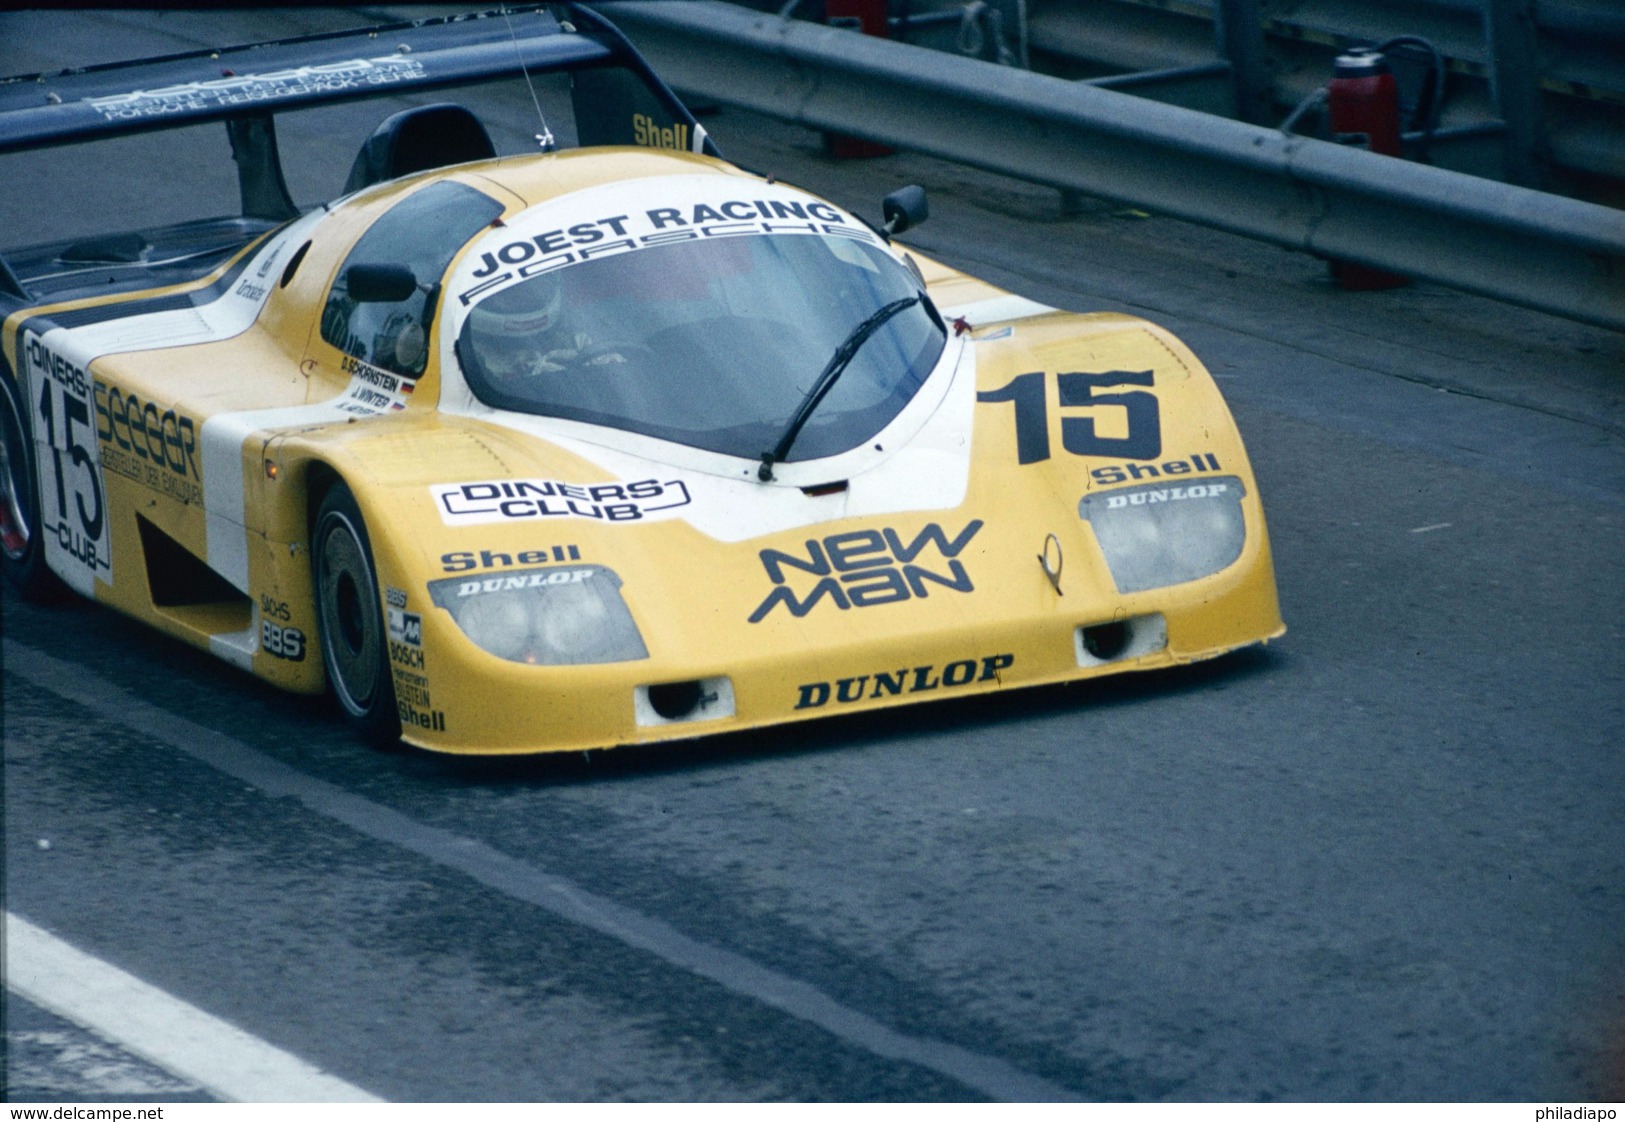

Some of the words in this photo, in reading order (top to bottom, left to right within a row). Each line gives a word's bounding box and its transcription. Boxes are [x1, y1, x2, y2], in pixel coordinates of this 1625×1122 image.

[633, 113, 687, 150] Shell
[472, 215, 629, 278] JOEST
[646, 200, 845, 229] RACING
[458, 222, 876, 306] PORSCHE
[32, 338, 87, 398] DINERS
[977, 369, 1162, 465] 15
[40, 377, 103, 541] 15
[1090, 453, 1221, 485] Shell
[460, 479, 664, 502] DINERS
[1107, 484, 1227, 509] DUNLOP
[500, 500, 643, 521] CLUB
[57, 521, 97, 570] CLUB
[440, 545, 581, 572] Shell
[387, 587, 407, 608] BBS
[457, 569, 593, 597] DUNLOP
[263, 618, 306, 662] BBS
[390, 641, 424, 670] BOSCH
[794, 653, 1014, 710] DUNLOP
[398, 700, 445, 732] Shell
